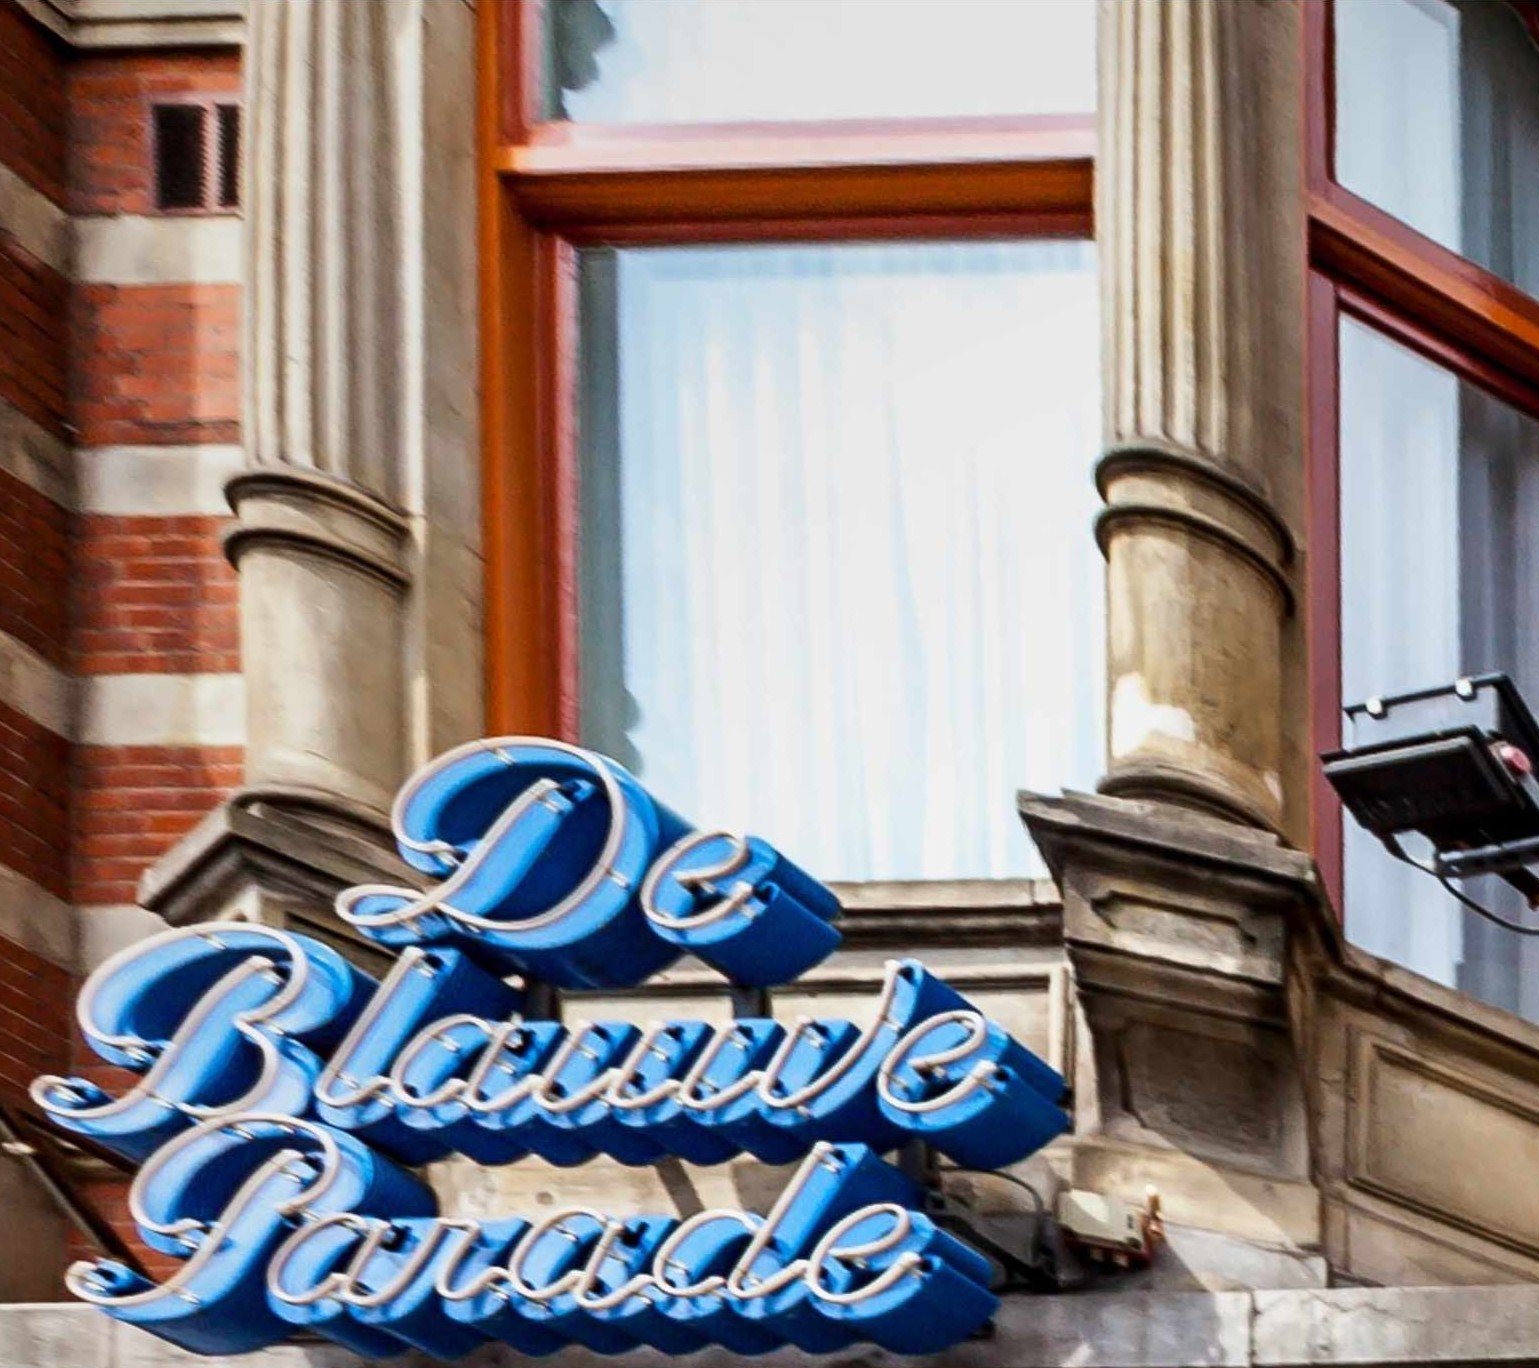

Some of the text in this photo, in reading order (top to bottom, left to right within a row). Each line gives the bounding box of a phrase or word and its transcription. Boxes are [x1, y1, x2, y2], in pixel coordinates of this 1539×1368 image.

[335, 736, 842, 986] De
[30, 922, 1069, 1167] Blauwe
[66, 1112, 996, 1356] Parade
